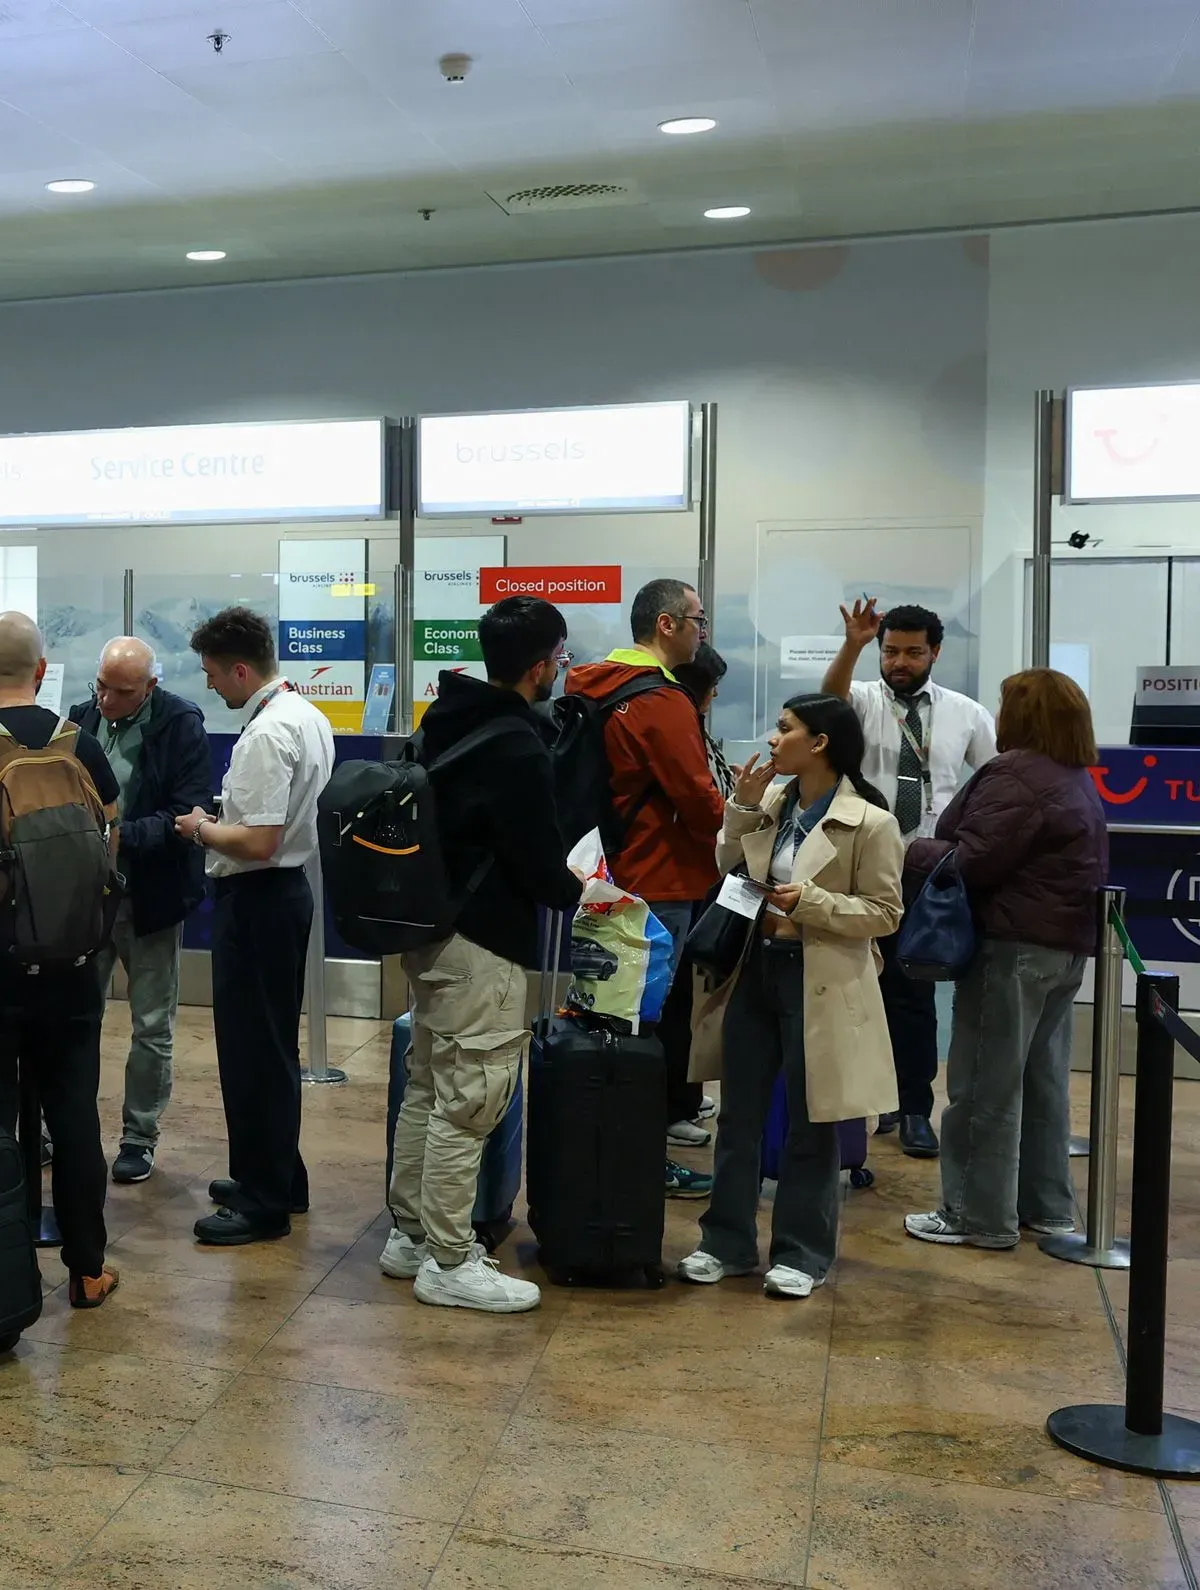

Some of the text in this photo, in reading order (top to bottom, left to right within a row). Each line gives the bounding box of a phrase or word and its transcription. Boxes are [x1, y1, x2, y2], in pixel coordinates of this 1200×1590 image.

[455, 437, 586, 464] brussels
[90, 455, 174, 480] Service
[180, 451, 266, 477] Centre
[289, 572, 335, 583] brussels
[424, 570, 471, 581] brussels
[495, 579, 606, 594] Closed position
[289, 627, 346, 639] Business
[424, 627, 479, 641] Econom
[289, 642, 323, 654] Class
[424, 642, 459, 654] Class
